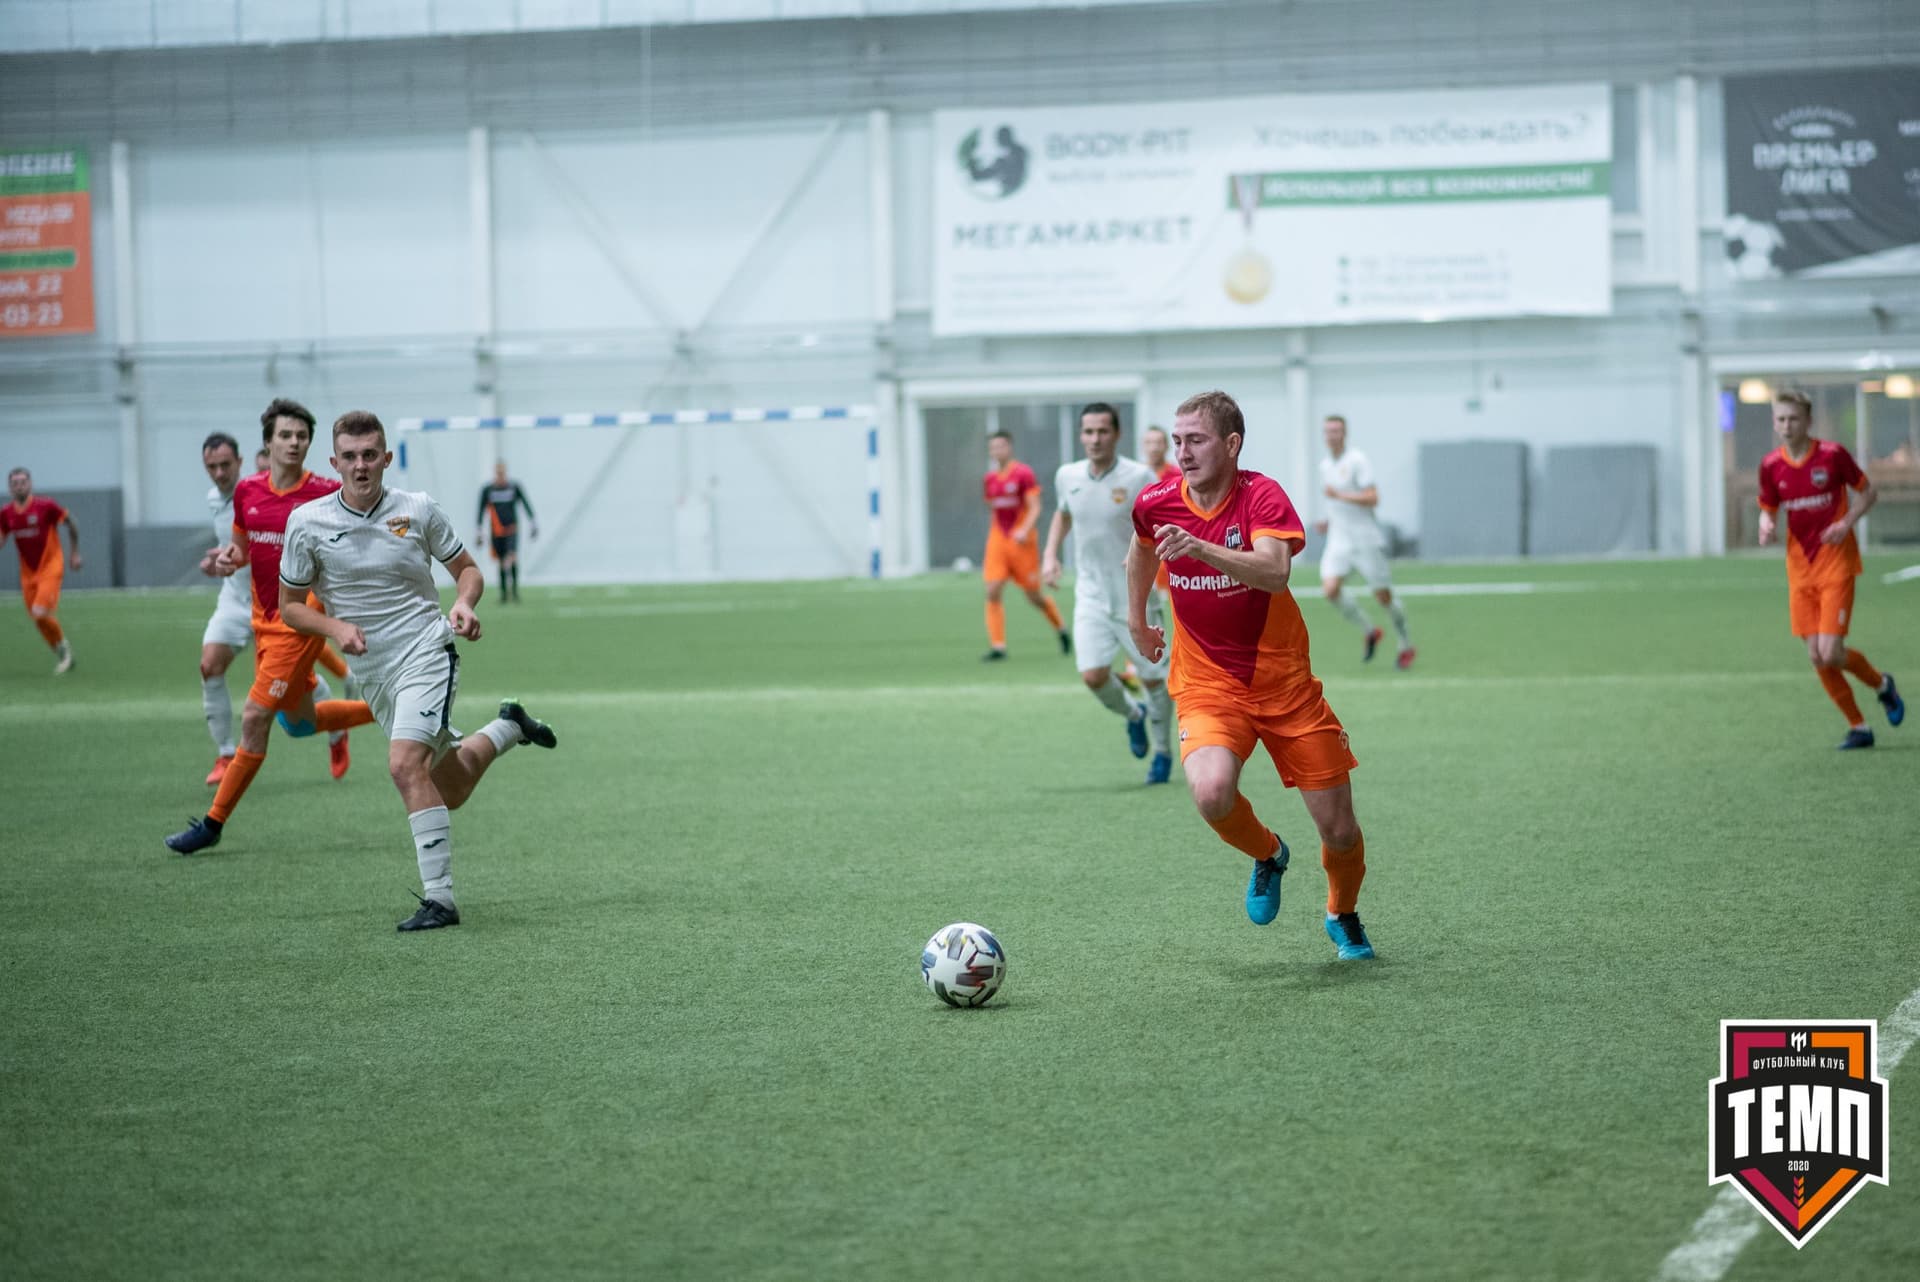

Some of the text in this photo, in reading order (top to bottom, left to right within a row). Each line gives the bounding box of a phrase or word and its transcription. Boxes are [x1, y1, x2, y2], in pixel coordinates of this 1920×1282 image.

[1753, 140, 1877, 169] ПРЕМЬЕР
[1780, 168, 1850, 194] ЛИГА
[954, 215, 1193, 249] МЕГАМАРКЕТ
